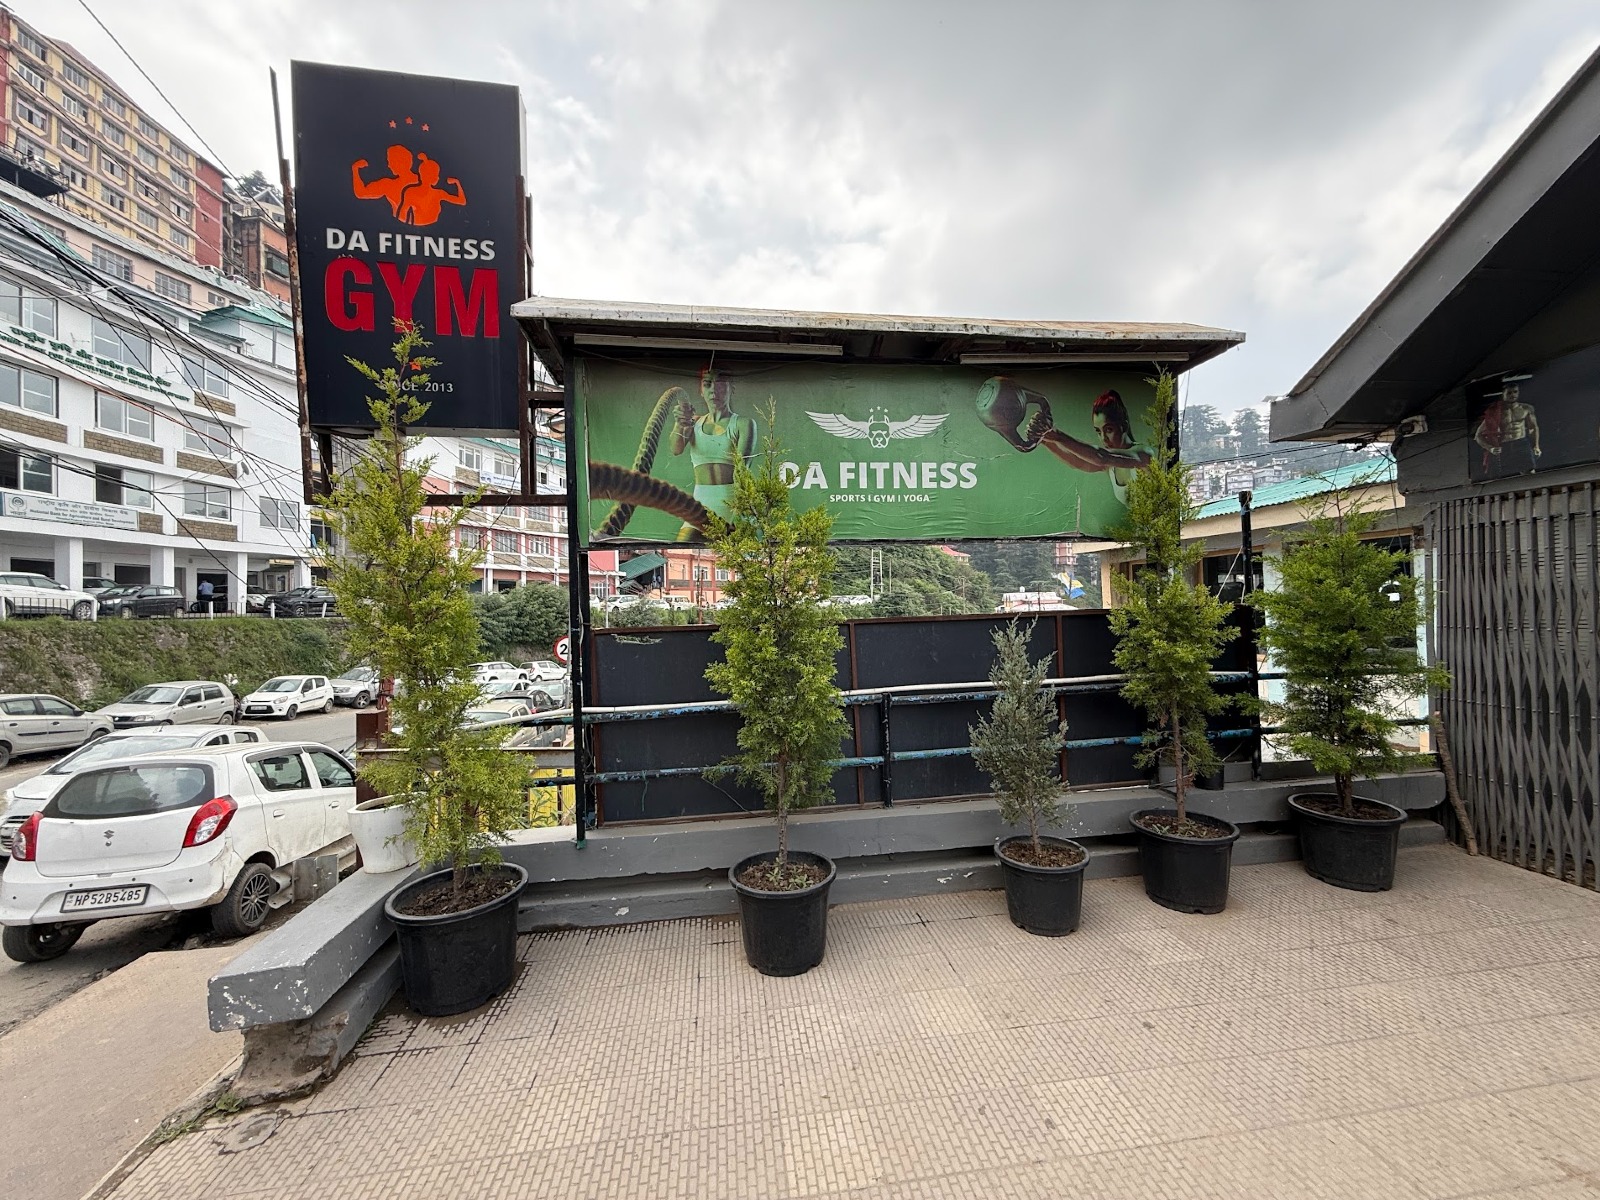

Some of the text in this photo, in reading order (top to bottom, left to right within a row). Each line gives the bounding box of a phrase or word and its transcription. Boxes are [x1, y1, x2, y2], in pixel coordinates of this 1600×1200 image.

[326, 227, 496, 261] DA FITNESS
[325, 257, 500, 338] GYM
[424, 382, 454, 393] 2013
[778, 461, 978, 490] DA FITNESS
[829, 494, 866, 503] SPORTS
[873, 494, 896, 503] GYM
[903, 494, 930, 502] YOGA
